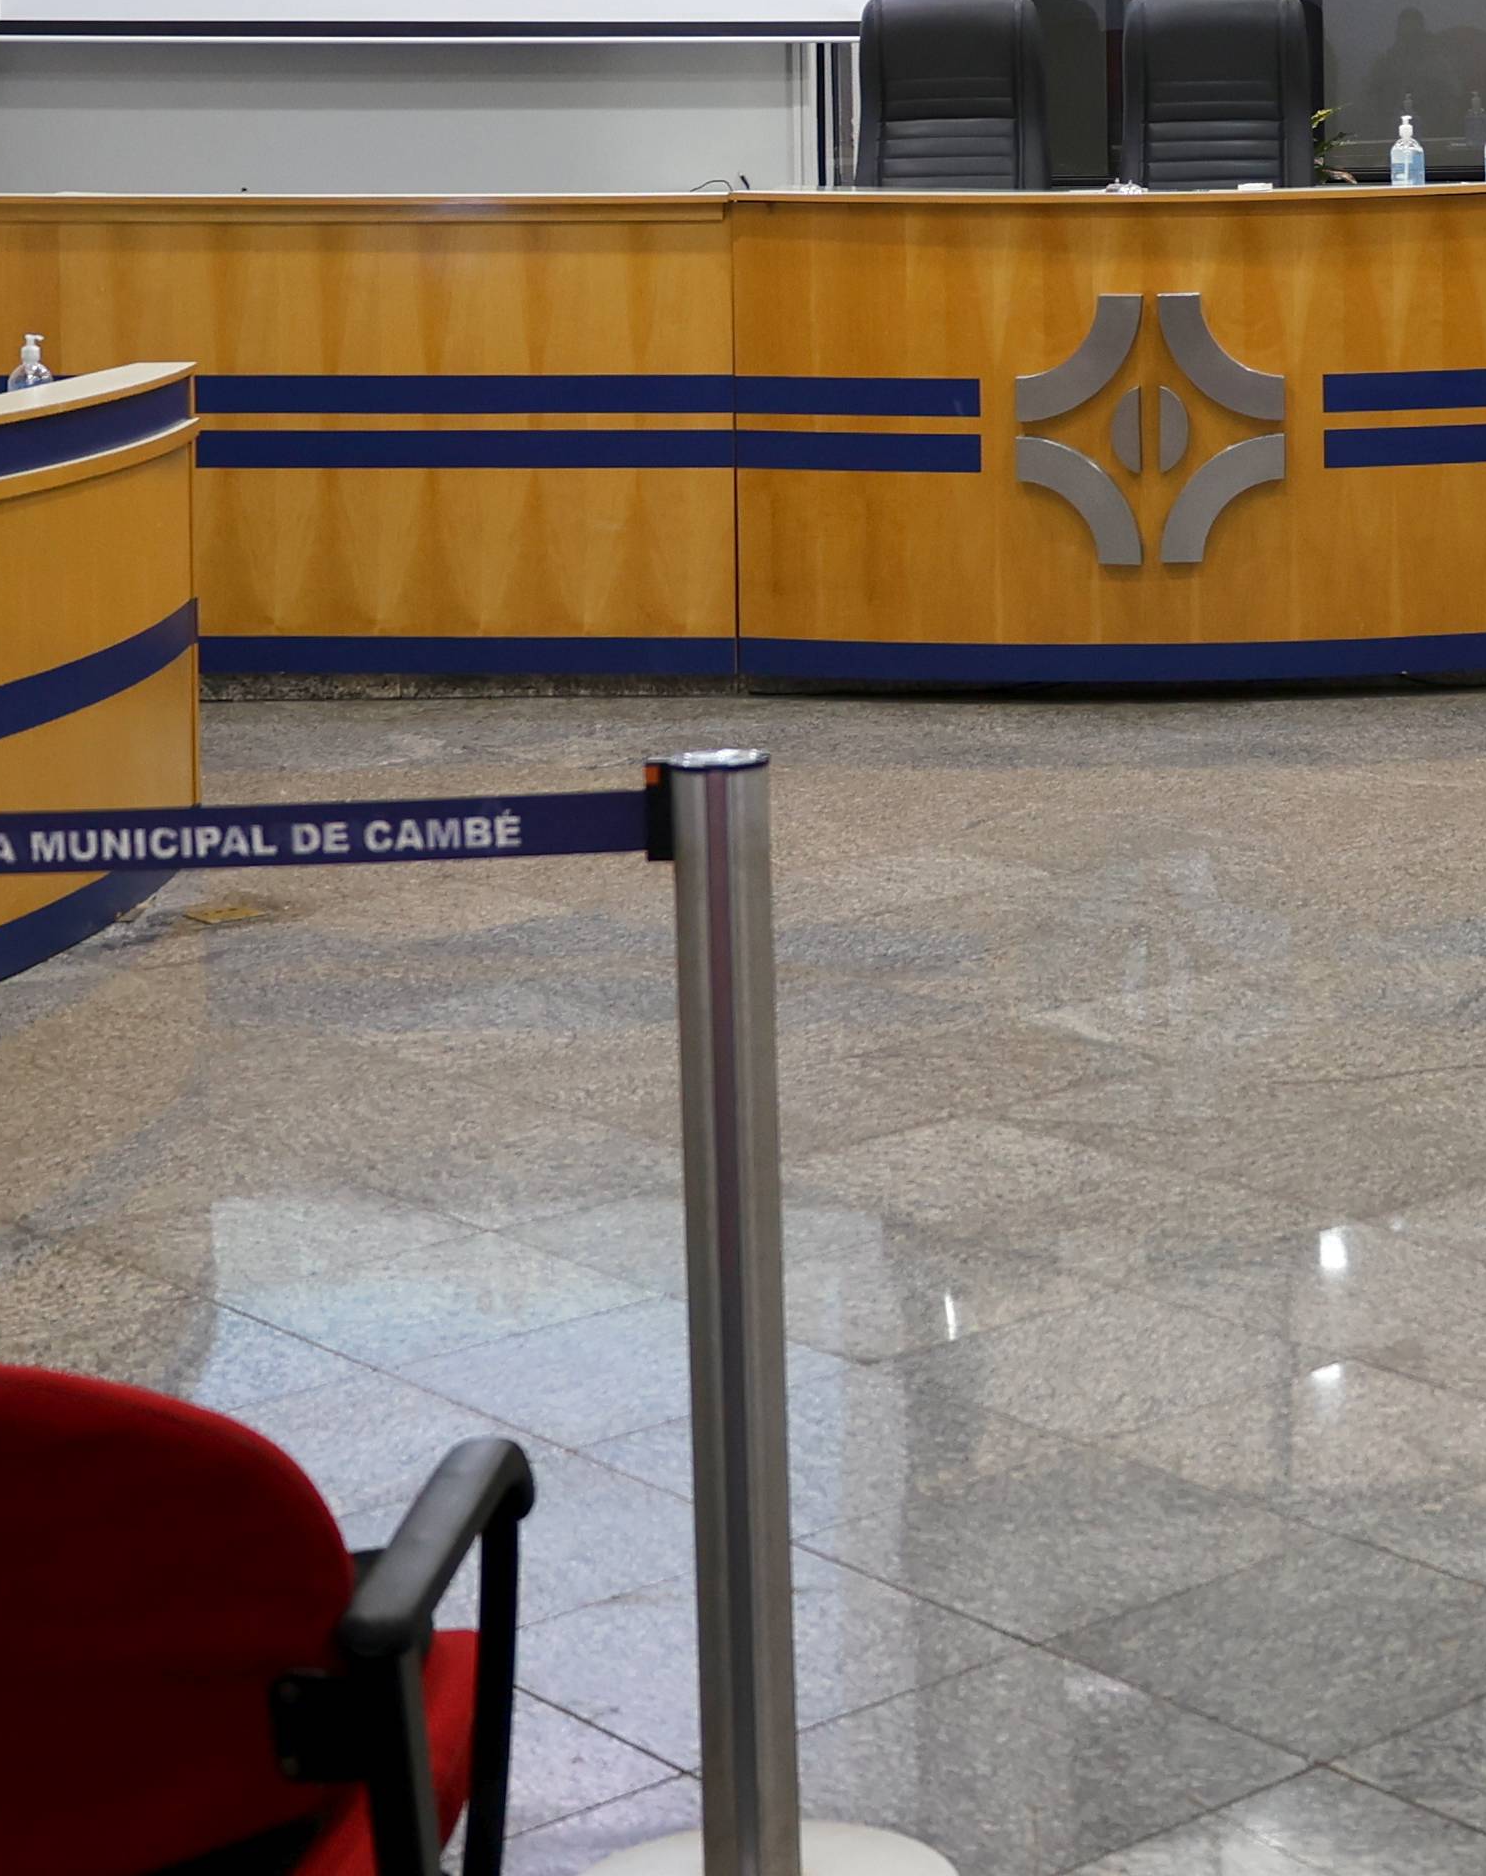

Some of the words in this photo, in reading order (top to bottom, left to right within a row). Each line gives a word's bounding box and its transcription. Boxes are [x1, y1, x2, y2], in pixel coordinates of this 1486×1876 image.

[30, 824, 278, 864] MUNICIPAL
[290, 822, 351, 856] DE
[363, 809, 523, 853] CAMBÉ
